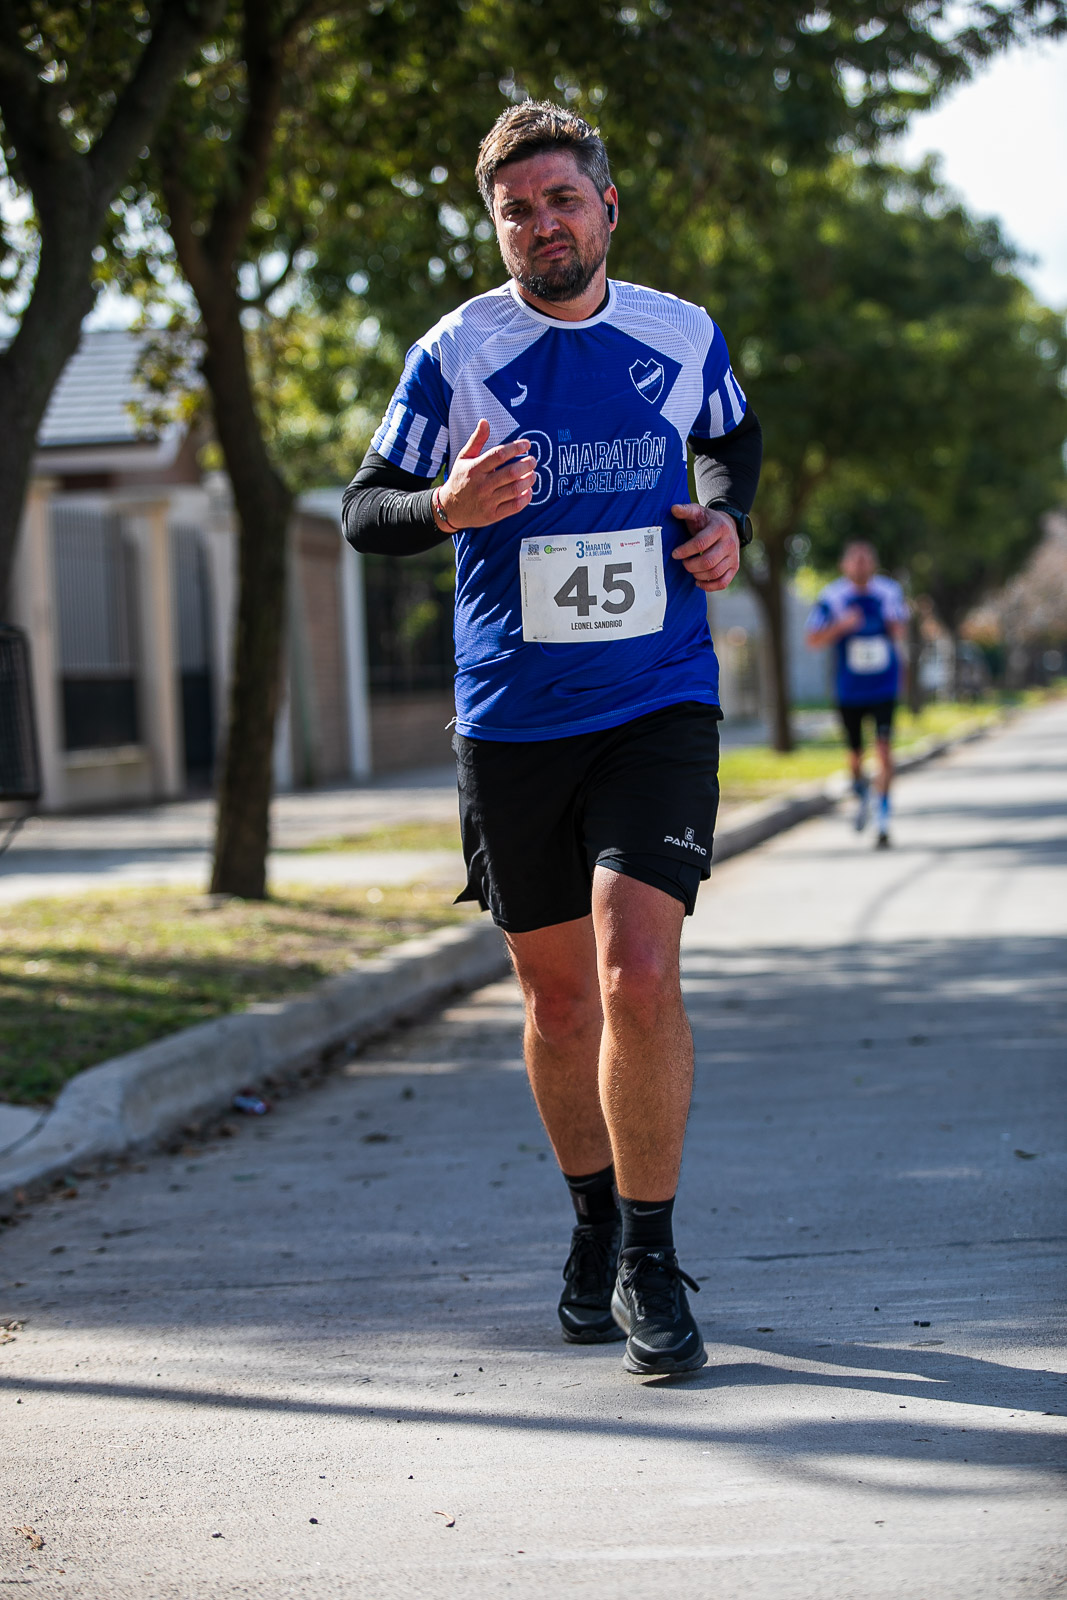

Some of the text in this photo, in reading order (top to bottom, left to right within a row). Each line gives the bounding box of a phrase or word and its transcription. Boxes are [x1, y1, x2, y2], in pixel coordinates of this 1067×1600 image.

[558, 431, 667, 475] MARATÓN
[576, 541, 585, 559] 3
[585, 542, 611, 551] MARATÓN
[554, 562, 635, 616] 45
[571, 619, 623, 630] LEONEL SANDRIGO
[664, 835, 707, 856] PANTRO
